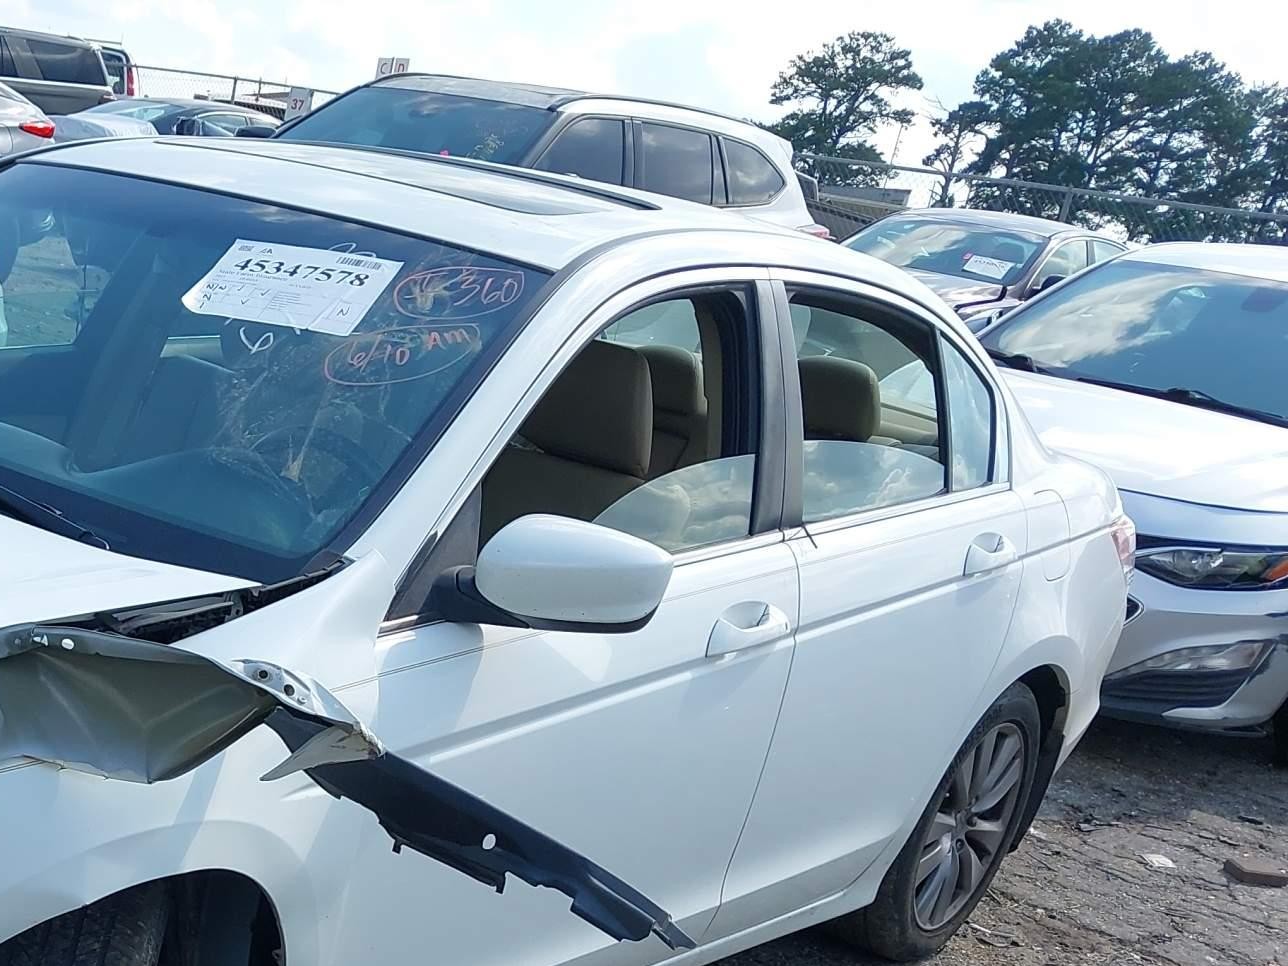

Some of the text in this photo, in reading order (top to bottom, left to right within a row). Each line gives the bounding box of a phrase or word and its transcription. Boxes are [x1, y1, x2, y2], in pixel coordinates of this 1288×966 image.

[380, 62, 388, 74] C
[290, 98, 305, 111] 37
[234, 258, 370, 287] 45347578
